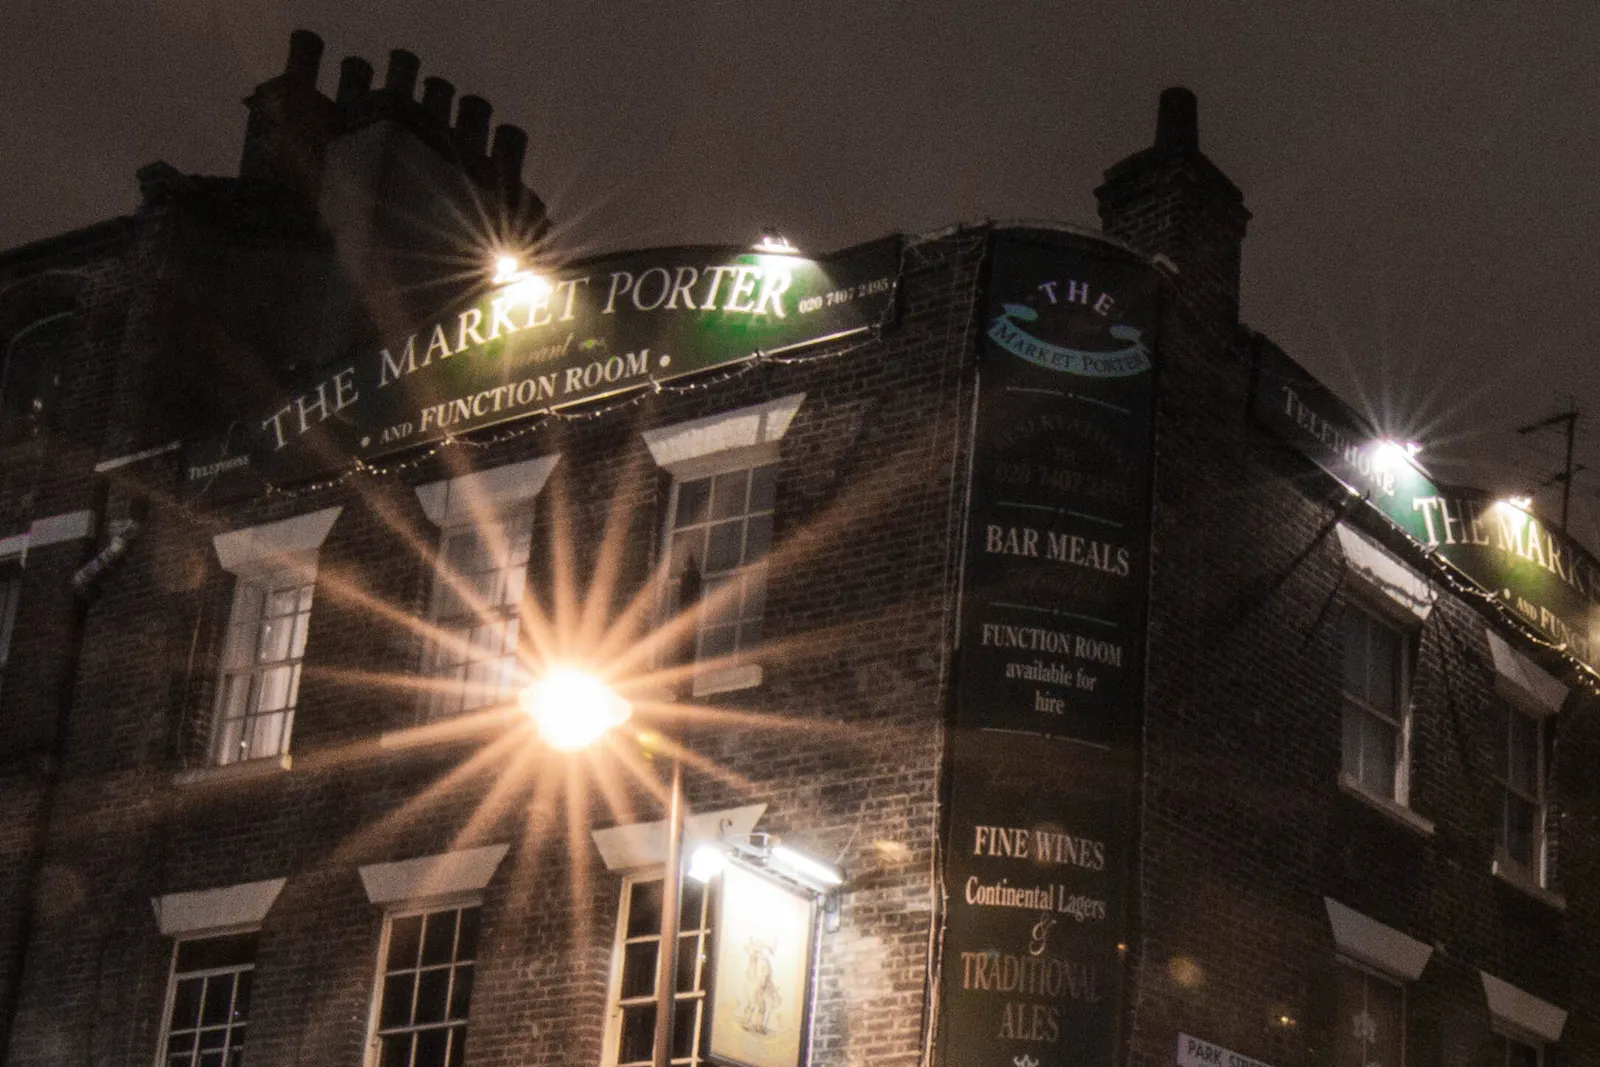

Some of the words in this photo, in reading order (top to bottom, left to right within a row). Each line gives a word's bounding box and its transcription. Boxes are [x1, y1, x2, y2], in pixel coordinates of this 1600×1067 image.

[1038, 278, 1116, 317] THE
[260, 366, 360, 453] THE
[377, 277, 589, 388] MARKET
[601, 263, 793, 319] PORTER
[993, 323, 1073, 370] MARKET
[1083, 350, 1146, 374] PORTER
[380, 421, 414, 446] AND
[418, 372, 558, 434] FUNCTION
[562, 347, 651, 395] ROOM
[1412, 495, 1490, 548] THE
[985, 525, 1040, 558] BAR
[1045, 531, 1131, 577] MEALS
[981, 623, 1072, 655] FUNCTION
[1075, 635, 1123, 668] ROOM
[1005, 659, 1073, 687] available
[1075, 666, 1097, 692] for
[1034, 689, 1065, 715] hire
[973, 825, 1029, 859] FINE
[1035, 830, 1105, 872] WINES
[964, 875, 1054, 911] Continental
[1057, 884, 1107, 921] Lagers
[961, 951, 1099, 1004] TRADITIONAL
[998, 1002, 1060, 1043] ALES
[1187, 1038, 1223, 1067] PARK
